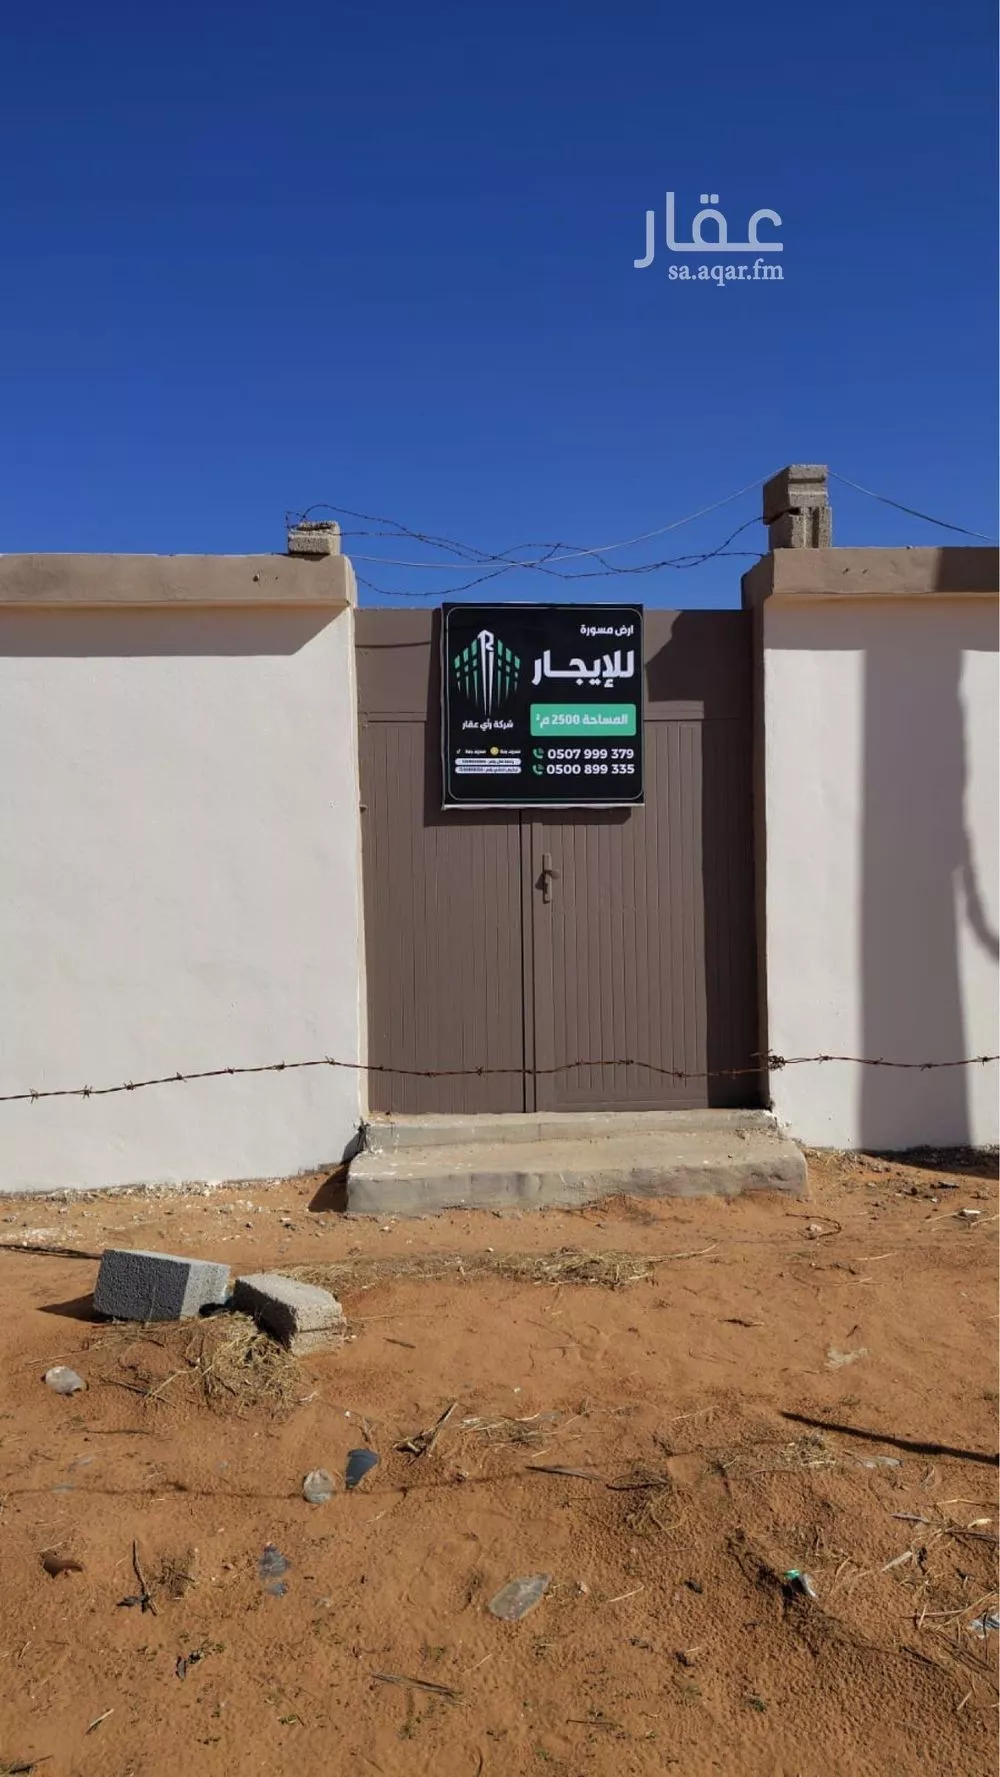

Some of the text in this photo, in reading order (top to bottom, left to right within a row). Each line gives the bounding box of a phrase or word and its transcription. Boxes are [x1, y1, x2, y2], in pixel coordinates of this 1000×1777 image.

[580, 624, 634, 637] ارض مسورة
[531, 649, 634, 688] للإيجار
[462, 720, 479, 730] عقار
[493, 719, 514, 730] شركة
[551, 714, 580, 725] 2500
[582, 714, 628, 725] المساحة
[547, 748, 634, 760] 0507 999 379
[546, 764, 635, 775] 0500 899 335
